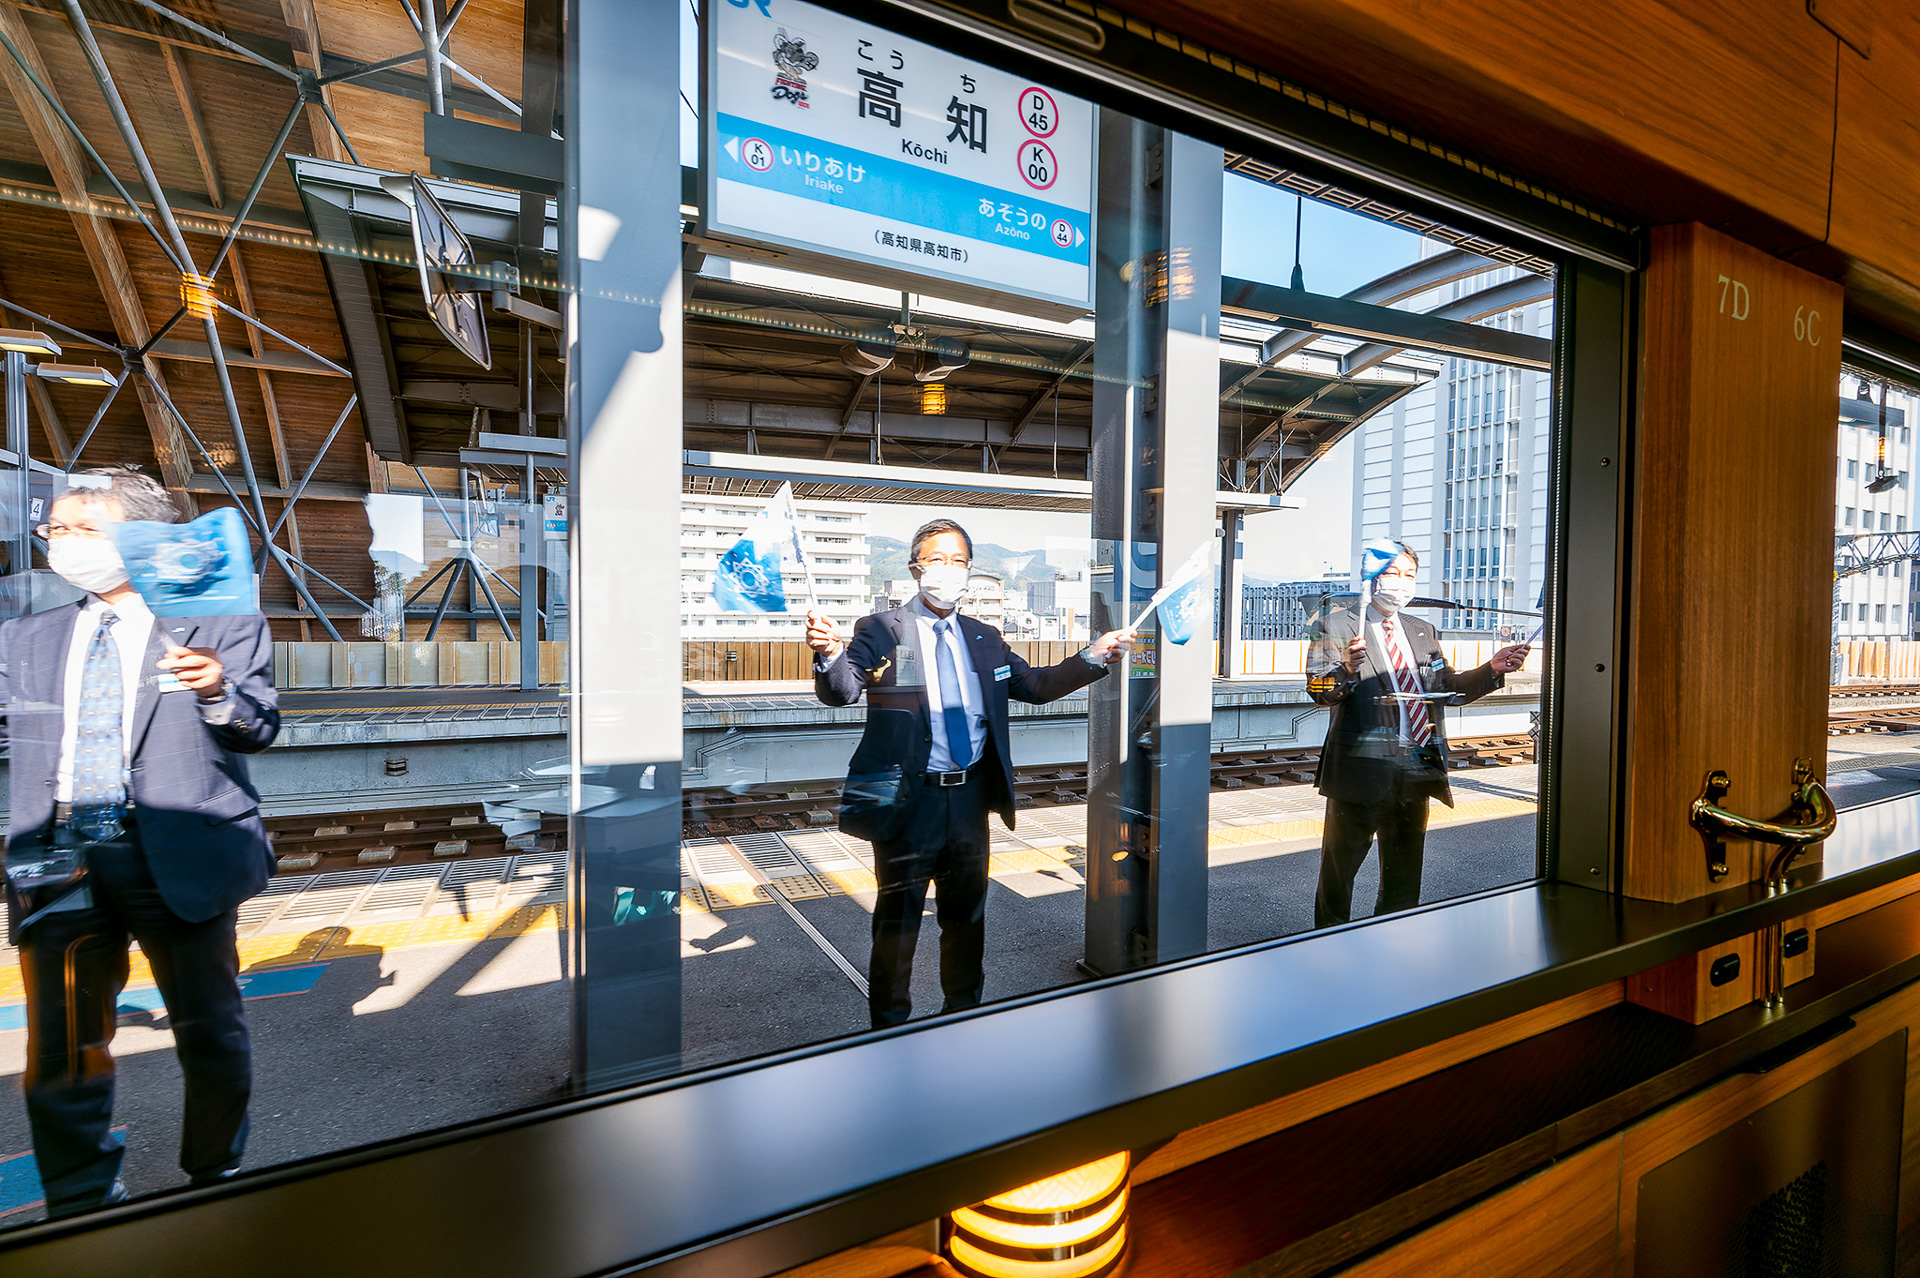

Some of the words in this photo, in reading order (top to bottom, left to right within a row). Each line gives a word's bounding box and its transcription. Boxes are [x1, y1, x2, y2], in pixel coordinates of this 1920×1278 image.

[857, 67, 988, 154] 高知
[1033, 94, 1044, 111] D
[1028, 112, 1048, 131] 45
[754, 143, 764, 155] K
[902, 138, 948, 165] Kōchi
[1033, 146, 1044, 164] K
[750, 154, 765, 167] 01
[780, 145, 867, 183] いりあけ
[1028, 163, 1048, 183] 00
[804, 173, 844, 194] Iriake
[978, 198, 1047, 231] あぞうの
[1056, 232, 1068, 243] 44
[1058, 223, 1066, 233] D
[1717, 274, 1750, 321] 7D
[1793, 305, 1821, 346] 6C
